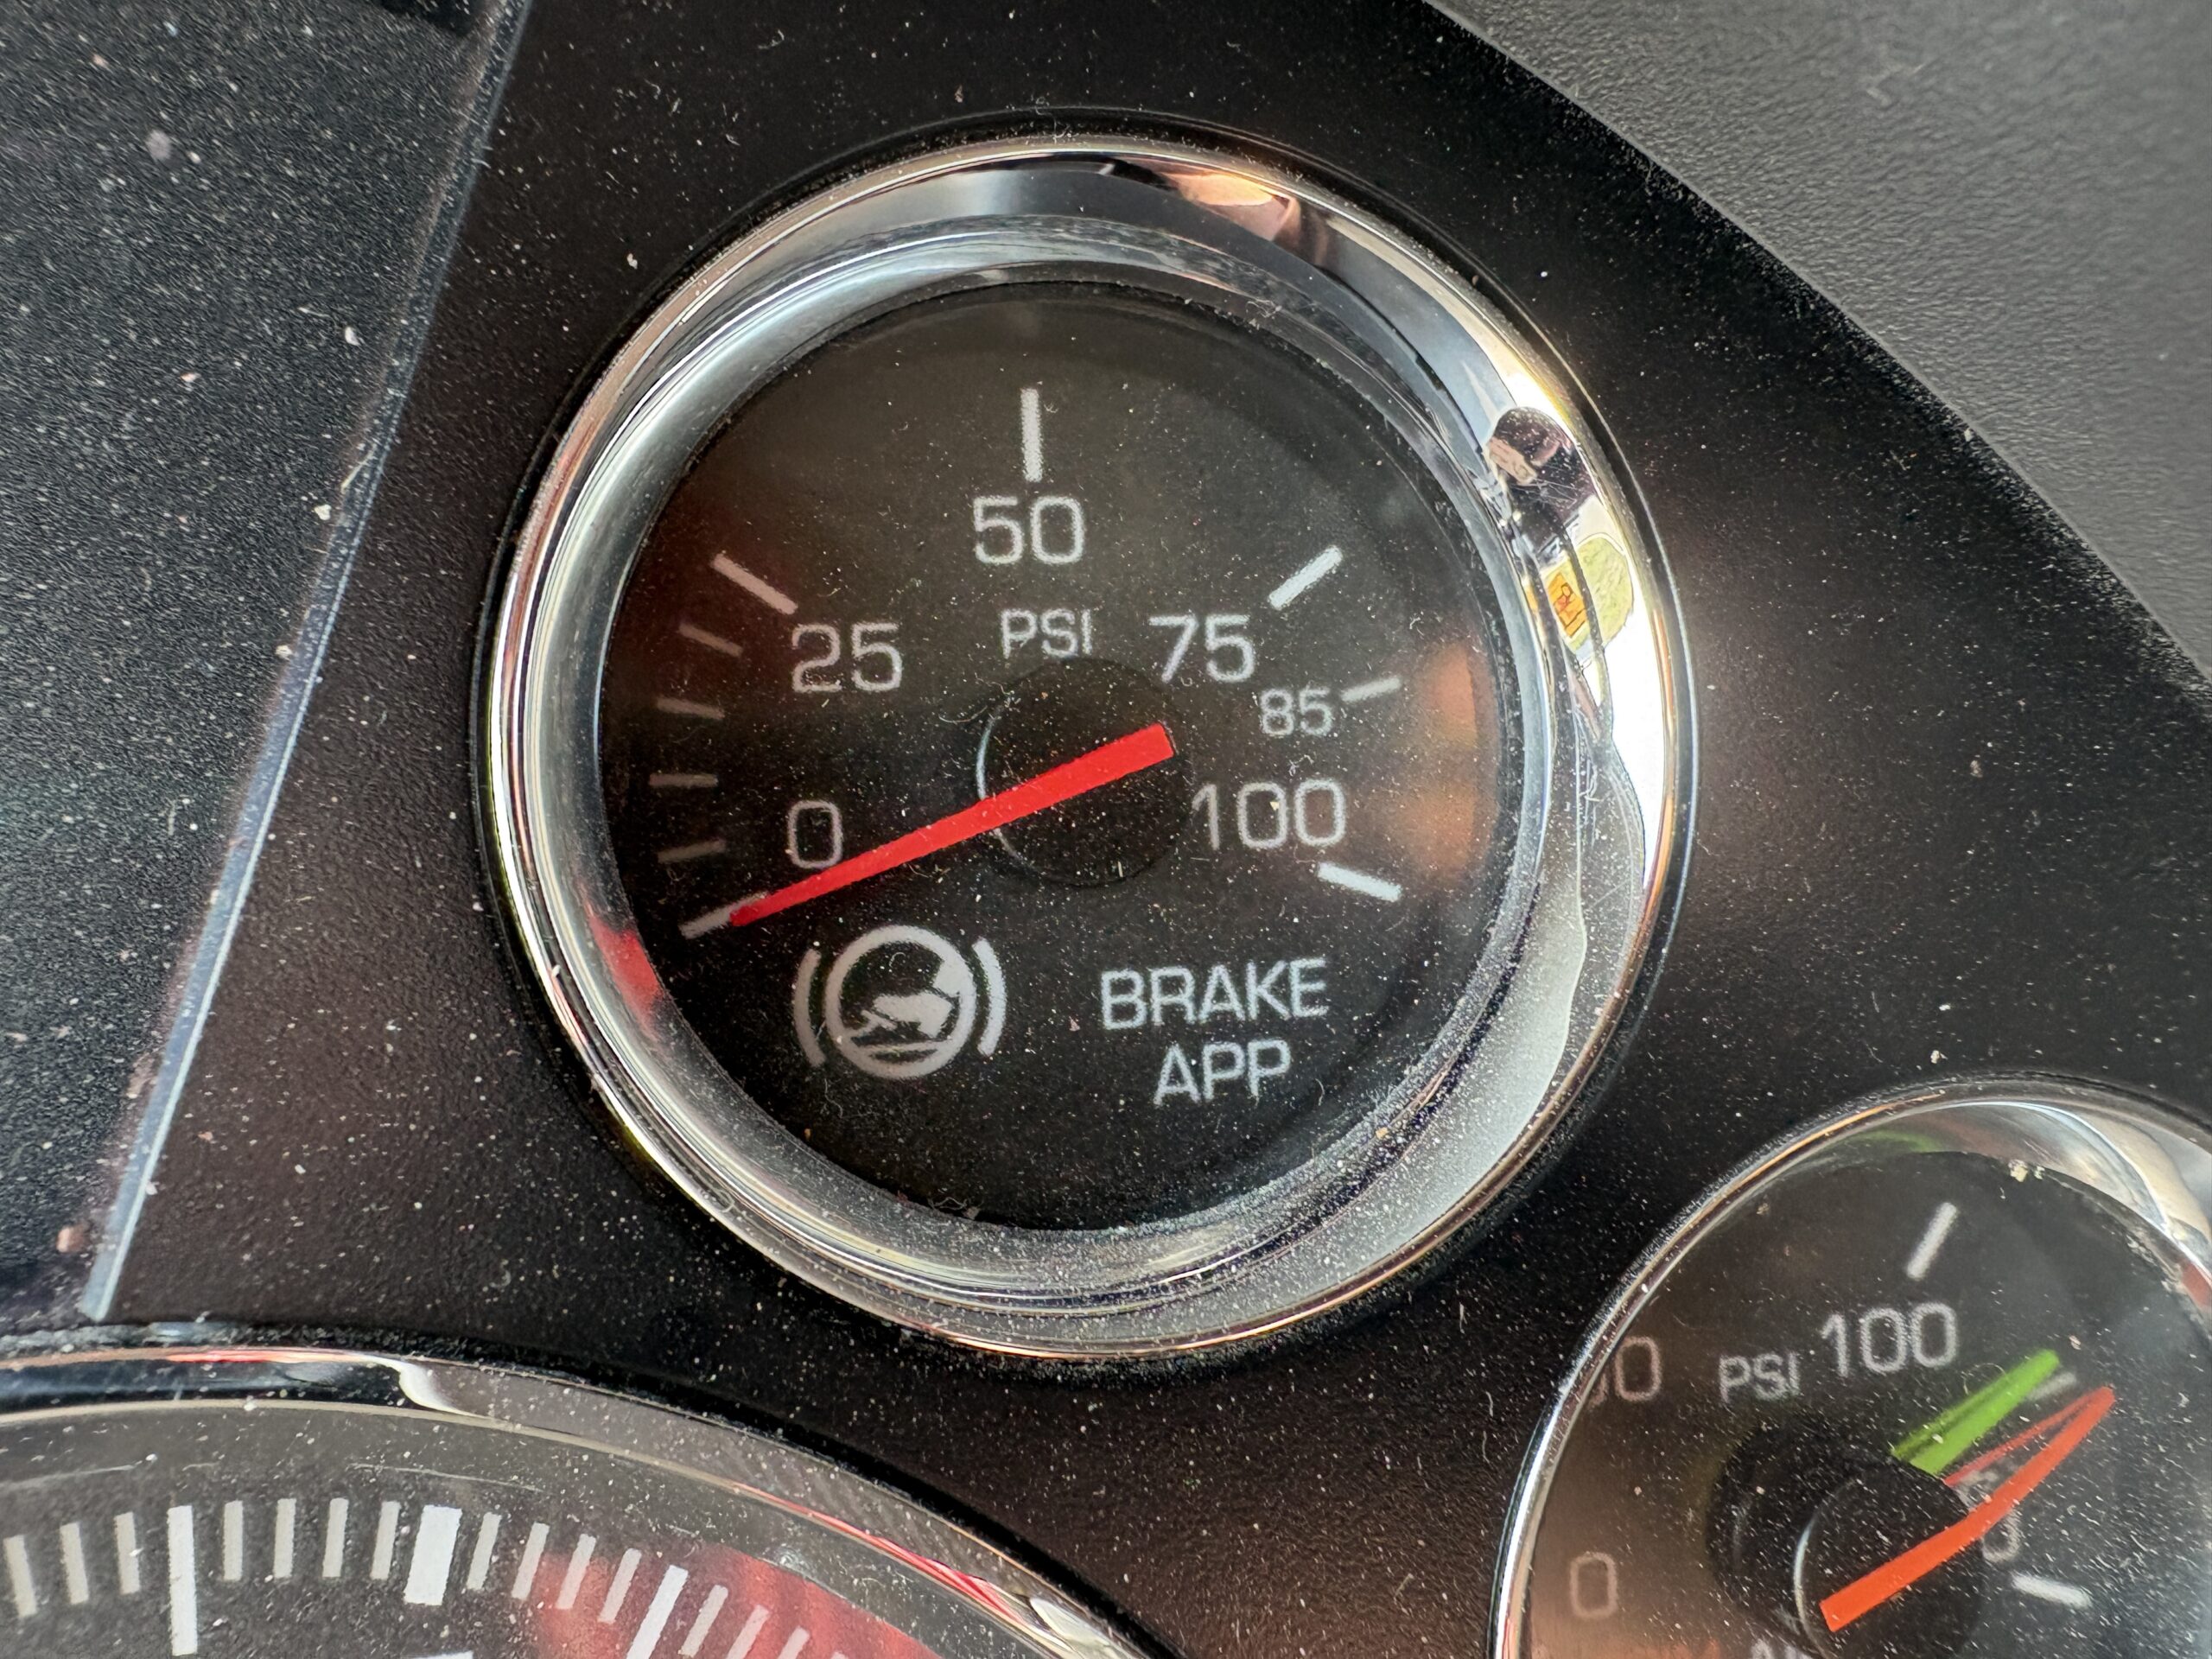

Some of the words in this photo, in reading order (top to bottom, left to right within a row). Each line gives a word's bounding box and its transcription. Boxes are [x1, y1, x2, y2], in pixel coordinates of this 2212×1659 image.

[973, 496, 1085, 564] 50
[791, 621, 904, 692] 25
[1001, 608, 1094, 658] PSI
[1149, 614, 1255, 683] 75
[1259, 690, 1334, 736] 85
[787, 799, 844, 868] 0
[1191, 779, 1347, 850] 100
[1100, 957, 1330, 1031] BRAKE
[1154, 1039, 1292, 1105] APP
[1820, 1302, 1958, 1378] 100
[1719, 1351, 1801, 1404] PSI
[1569, 1552, 1618, 1619] 0
